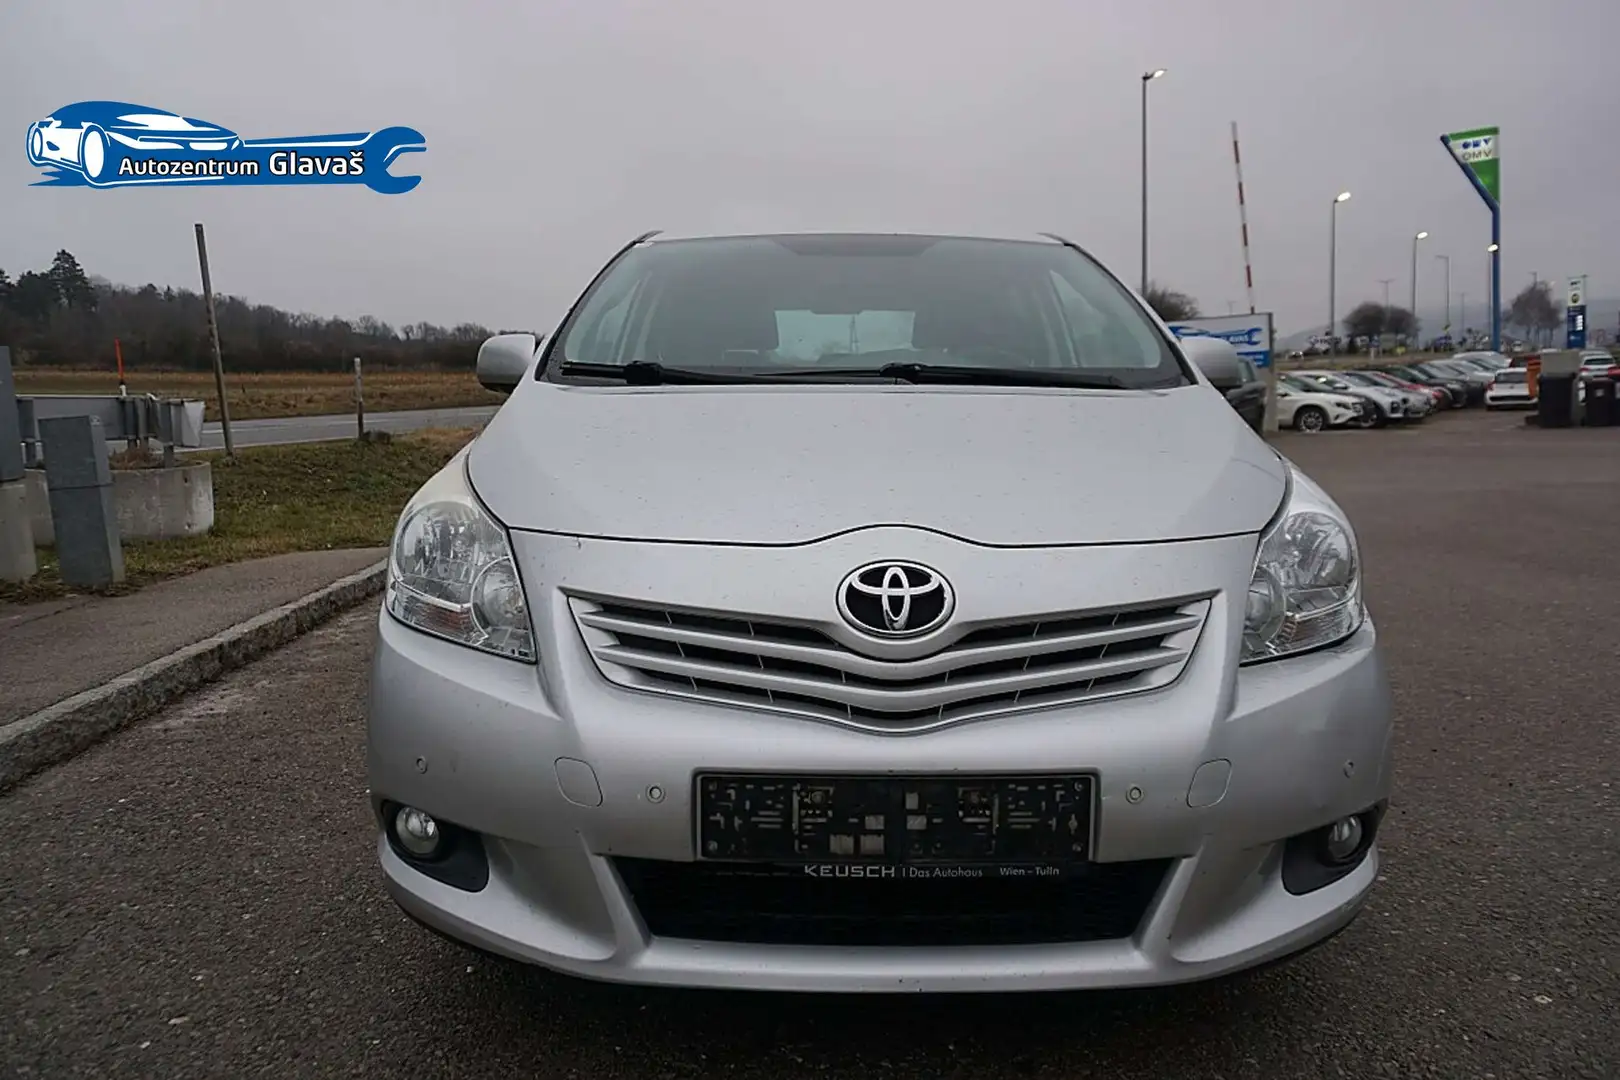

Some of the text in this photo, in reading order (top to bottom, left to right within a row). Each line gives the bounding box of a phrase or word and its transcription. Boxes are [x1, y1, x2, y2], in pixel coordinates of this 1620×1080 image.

[1462, 149, 1492, 160] OMV
[804, 864, 896, 878] KEUSCH
[909, 866, 930, 878] Das
[932, 865, 983, 878] Autohaus
[999, 866, 1026, 877] Wien
